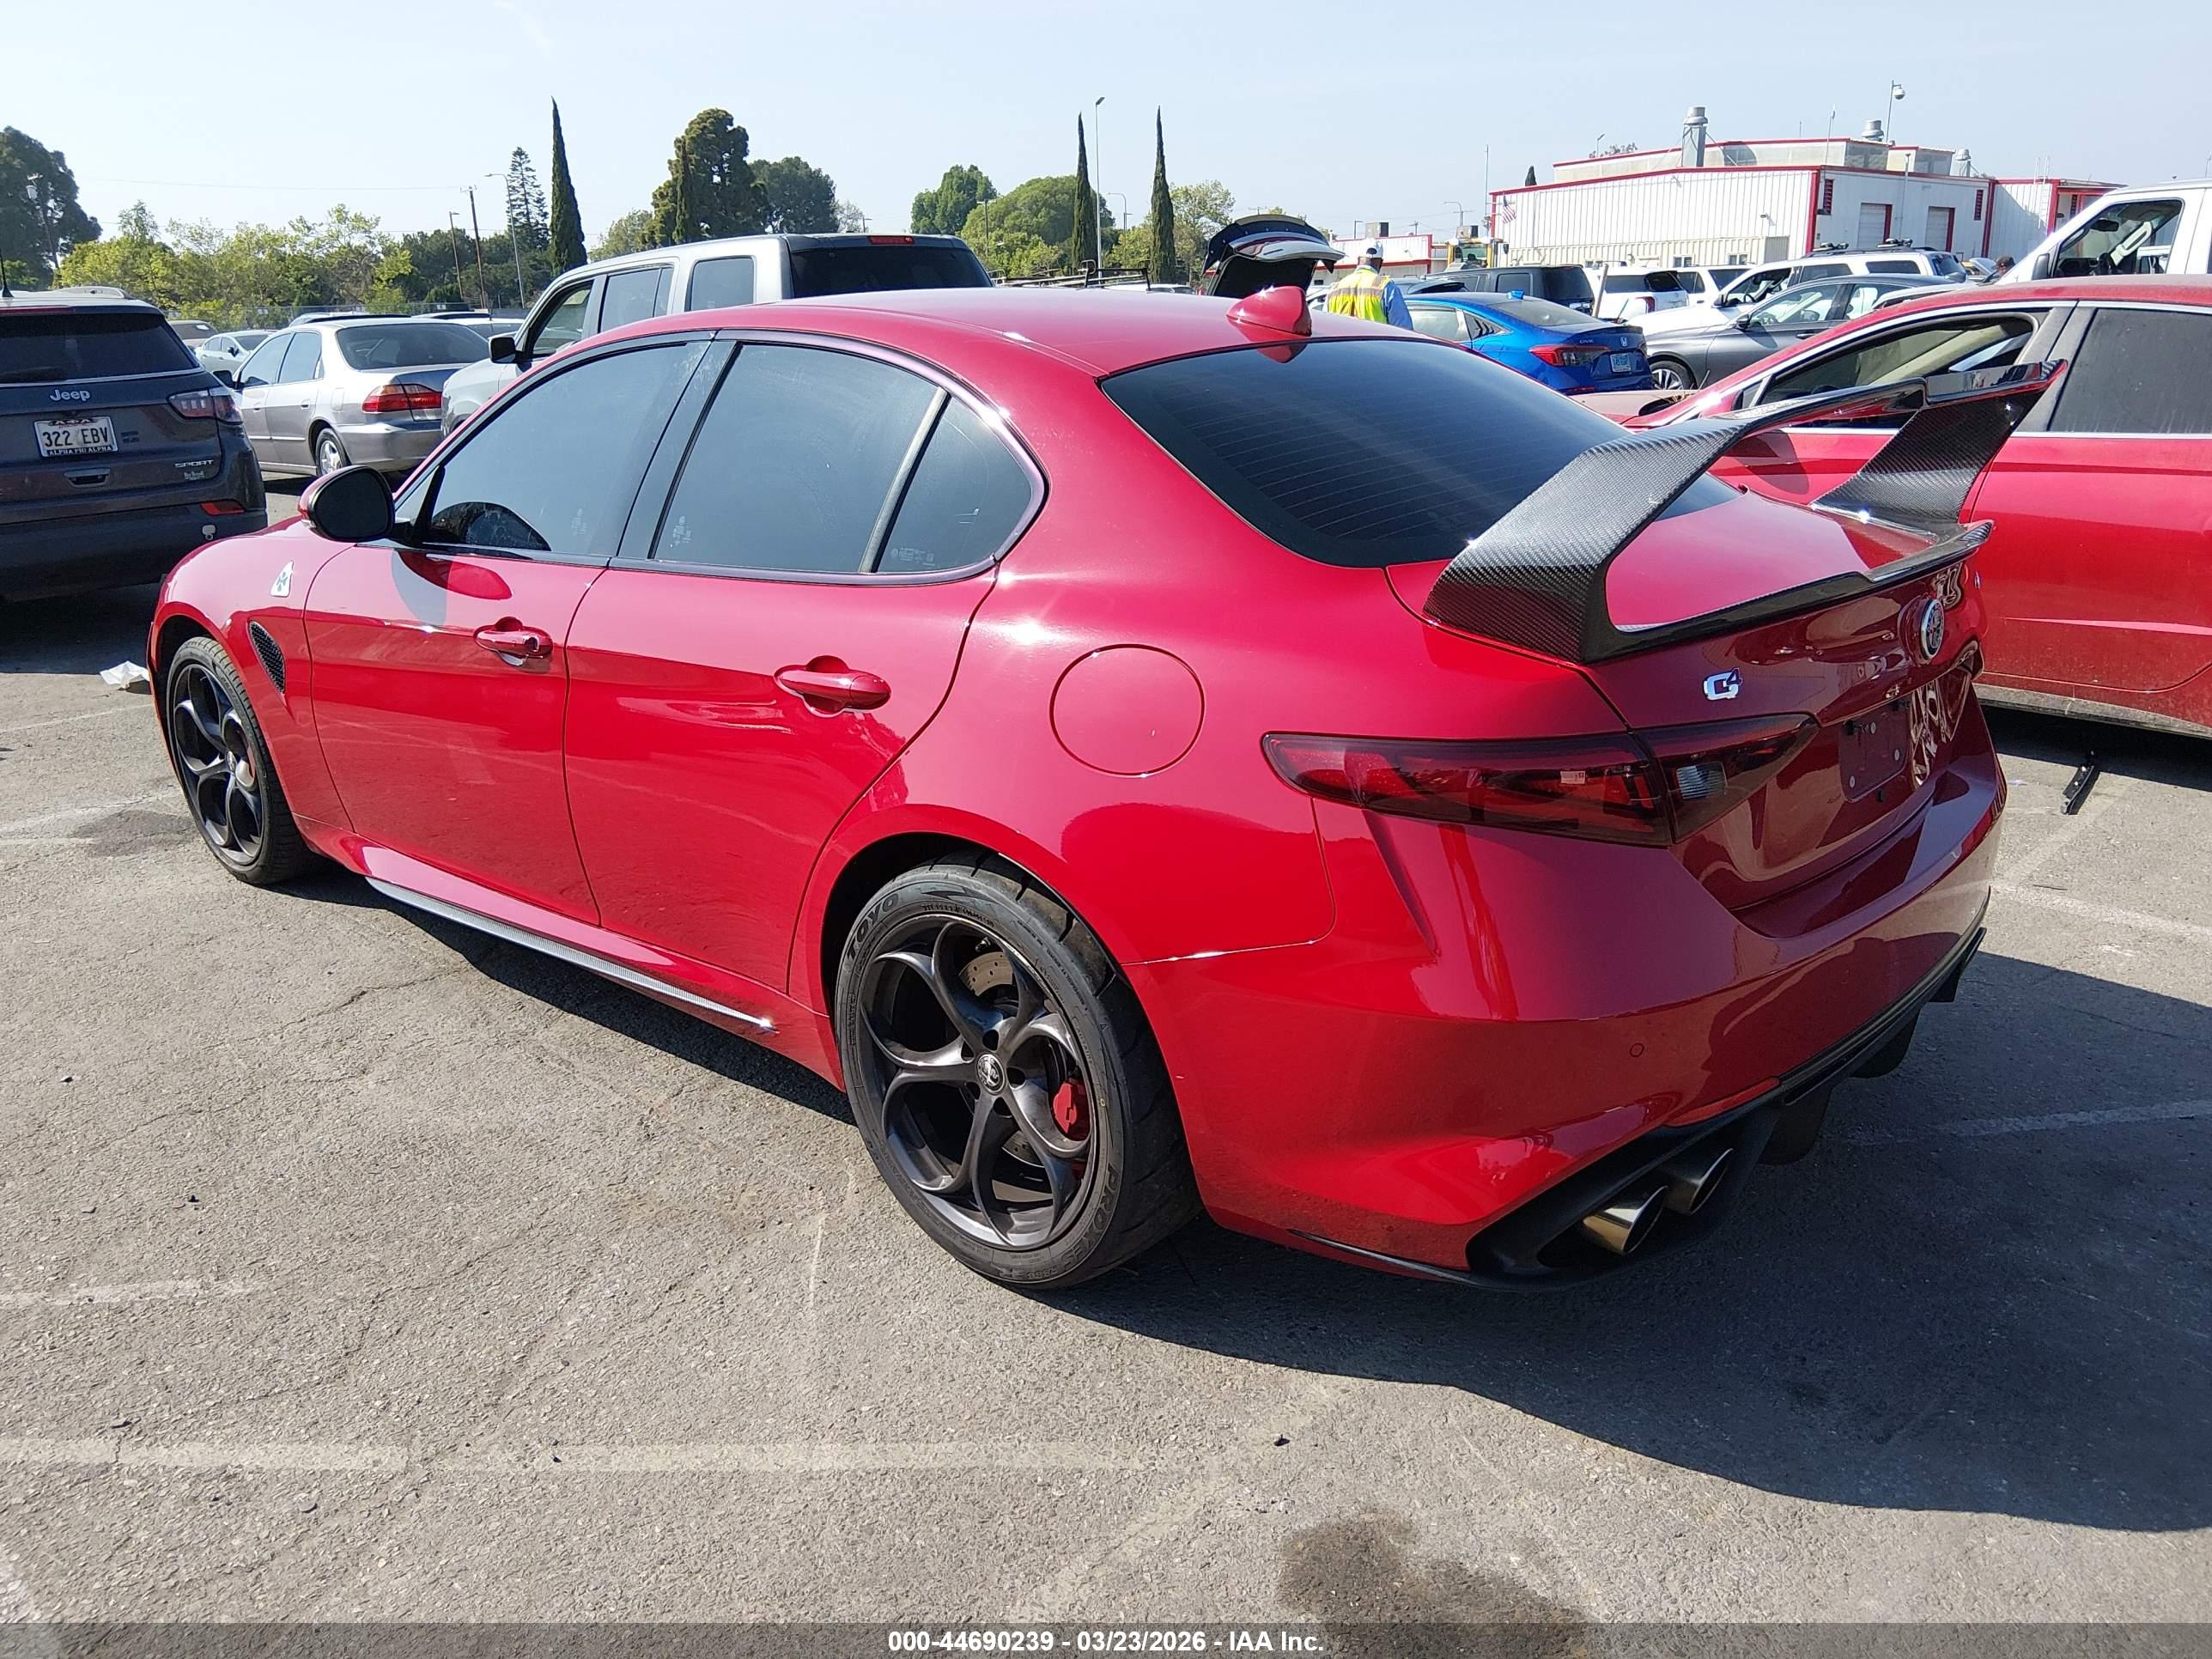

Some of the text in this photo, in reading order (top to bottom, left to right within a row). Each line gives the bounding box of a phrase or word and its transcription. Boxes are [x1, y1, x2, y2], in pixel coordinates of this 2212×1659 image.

[49, 389, 91, 402] Jeep
[42, 426, 108, 447] 322 EBV
[88, 445, 112, 453] ALPHA
[174, 459, 215, 468] SPORT
[847, 892, 899, 962] TOYO
[1062, 1162, 1121, 1268] PROXES
